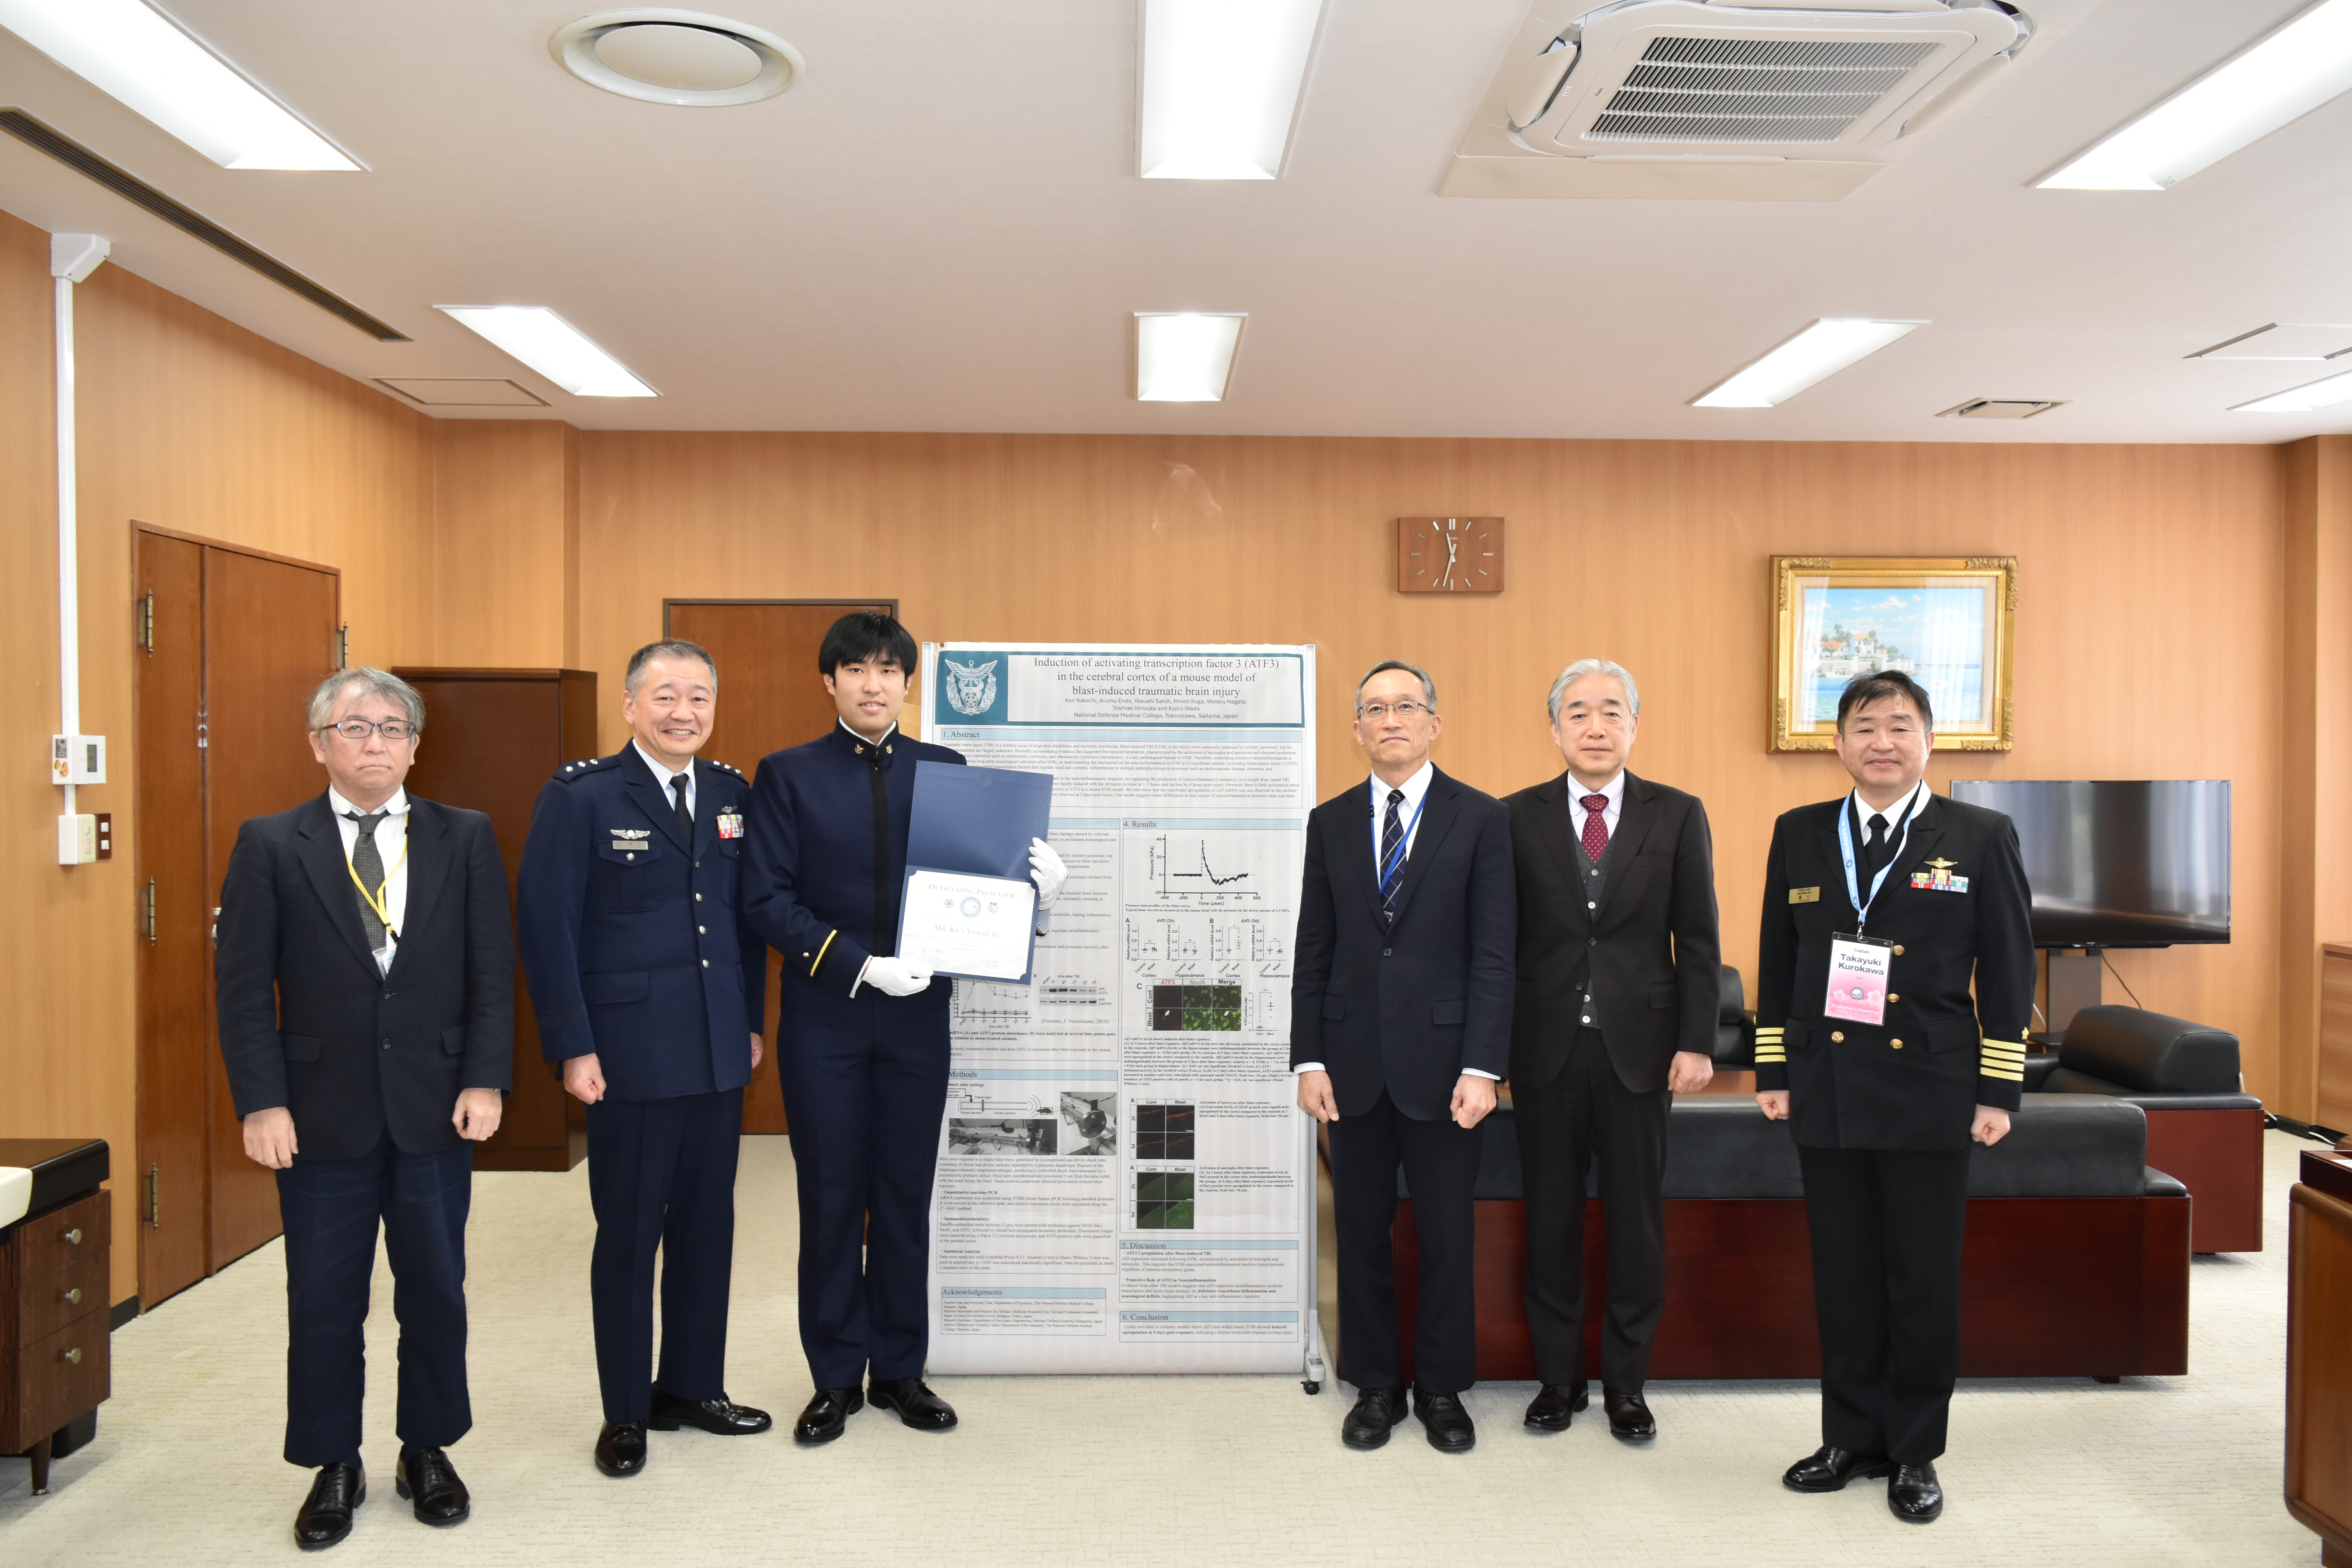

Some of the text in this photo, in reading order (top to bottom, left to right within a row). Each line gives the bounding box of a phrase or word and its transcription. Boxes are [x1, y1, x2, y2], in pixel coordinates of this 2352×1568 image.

[1034, 657, 1278, 670] Induction of activating transcription factor 3 (ATF3)
[1058, 671, 1066, 680] in
[1069, 671, 1083, 681] the
[1086, 672, 1123, 681] cerebral
[1159, 672, 1170, 681] of
[1214, 673, 1242, 681] model
[1245, 673, 1257, 681] of
[1072, 686, 1240, 698] blast-induced traumatic brain injury
[1840, 953, 1881, 966] Takayuki
[1838, 962, 1884, 975] Kurokawa
